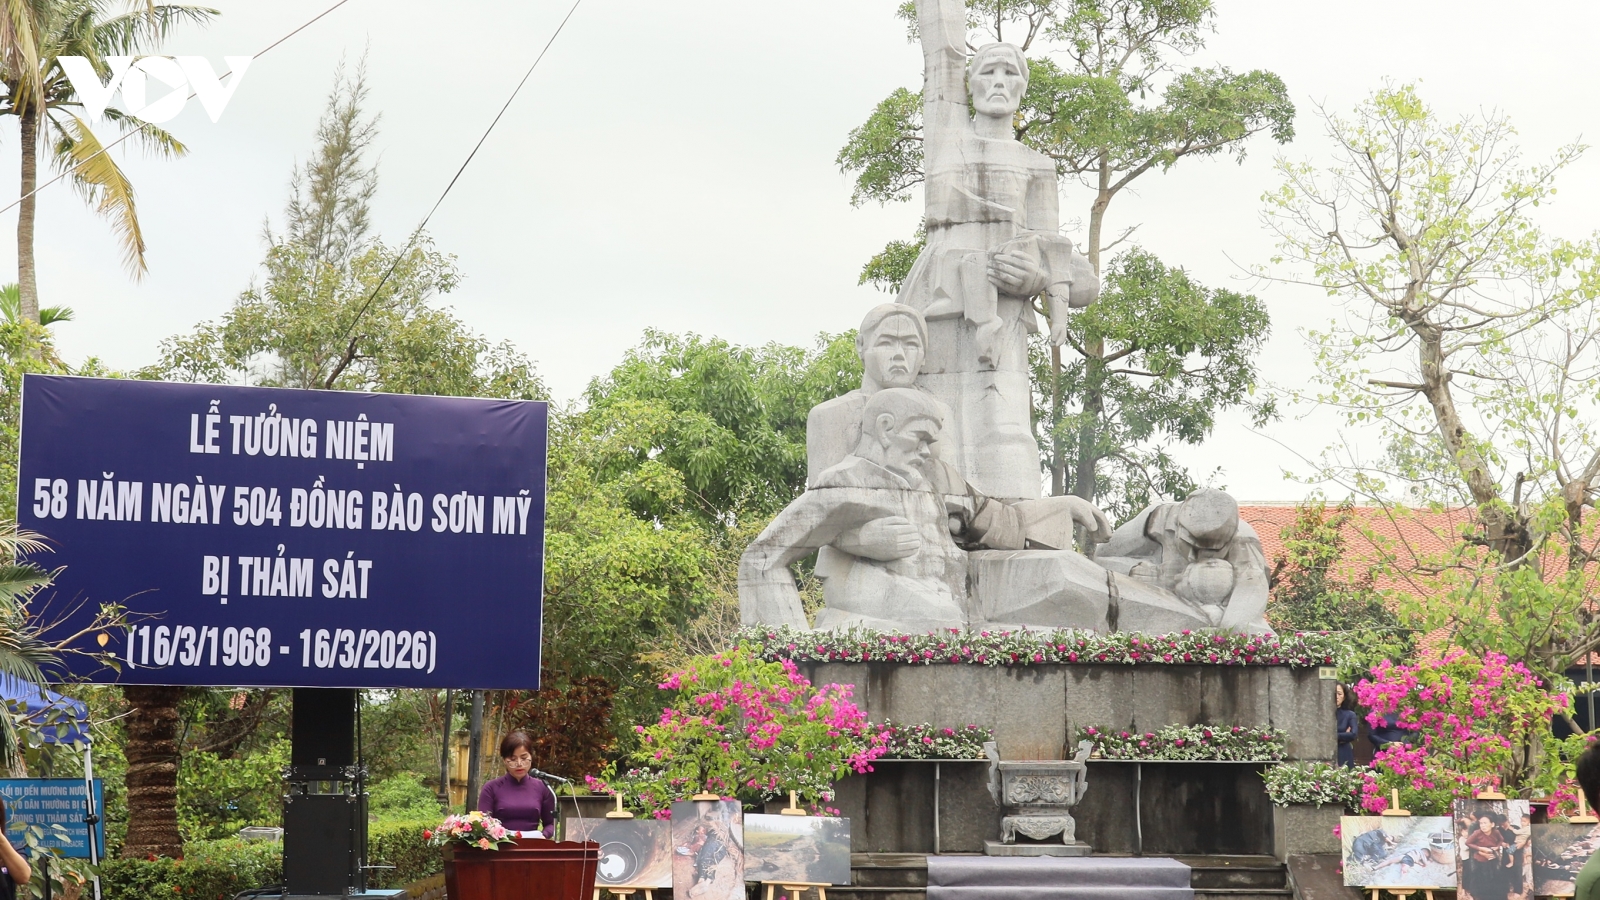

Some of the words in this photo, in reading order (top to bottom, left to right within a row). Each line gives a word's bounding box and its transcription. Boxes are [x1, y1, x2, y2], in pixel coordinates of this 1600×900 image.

[189, 399, 221, 454] LỄ
[229, 403, 318, 459] TƯỞNG
[325, 413, 395, 470] NIỆM
[33, 478, 69, 520] 58
[76, 471, 143, 521] NĂM
[150, 475, 227, 525] NGÀY
[232, 486, 283, 527] 504
[289, 475, 364, 530] ĐỒNG
[371, 483, 424, 532] BÀO
[431, 491, 485, 534] SƠN
[492, 488, 532, 535] MỸ
[202, 555, 230, 605] BỊ
[238, 543, 314, 598] THẢM
[321, 551, 373, 599] SÁT
[126, 624, 272, 670] (16/3/1968
[279, 645, 290, 655] -
[300, 628, 437, 674] 16/3/2026)
[24, 784, 38, 796] ĐẾN
[24, 799, 39, 810] DÂN
[72, 800, 80, 811] BỊ
[46, 811, 67, 823] THẢM
[69, 812, 83, 823] SÁT
